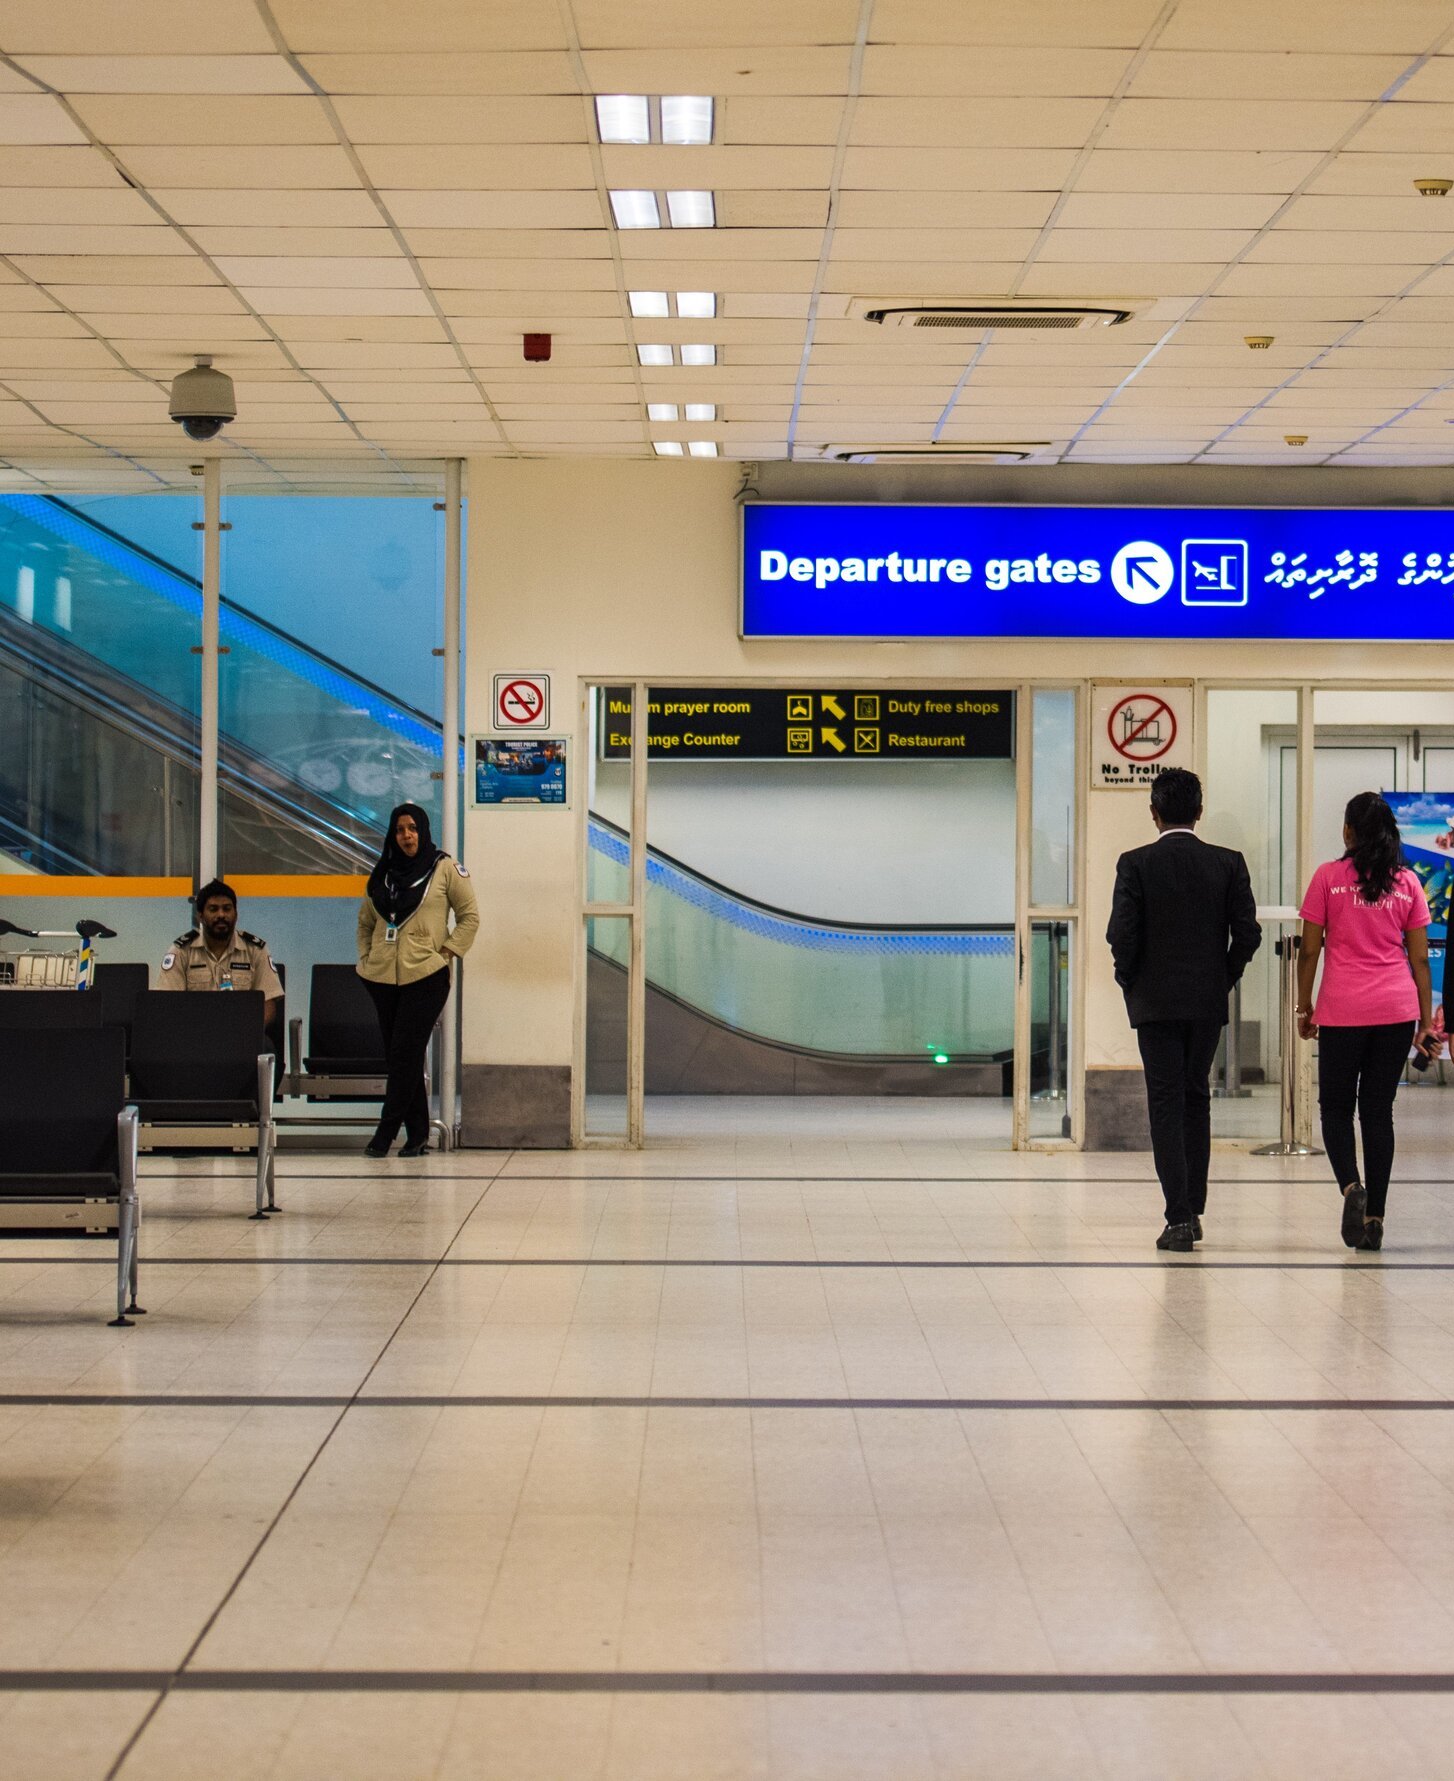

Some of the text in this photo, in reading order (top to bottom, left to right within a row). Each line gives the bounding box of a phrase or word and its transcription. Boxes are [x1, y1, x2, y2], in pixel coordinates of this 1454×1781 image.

[760, 550, 1101, 591] Departure gates
[664, 702, 710, 717] prayer
[713, 703, 750, 714] room
[888, 700, 999, 716] Duty free shops
[683, 732, 741, 746] Counter
[888, 734, 966, 747] Restaurant
[1102, 764, 1119, 774] No
[1105, 776, 1134, 784] beyond
[1330, 885, 1347, 895] WE
